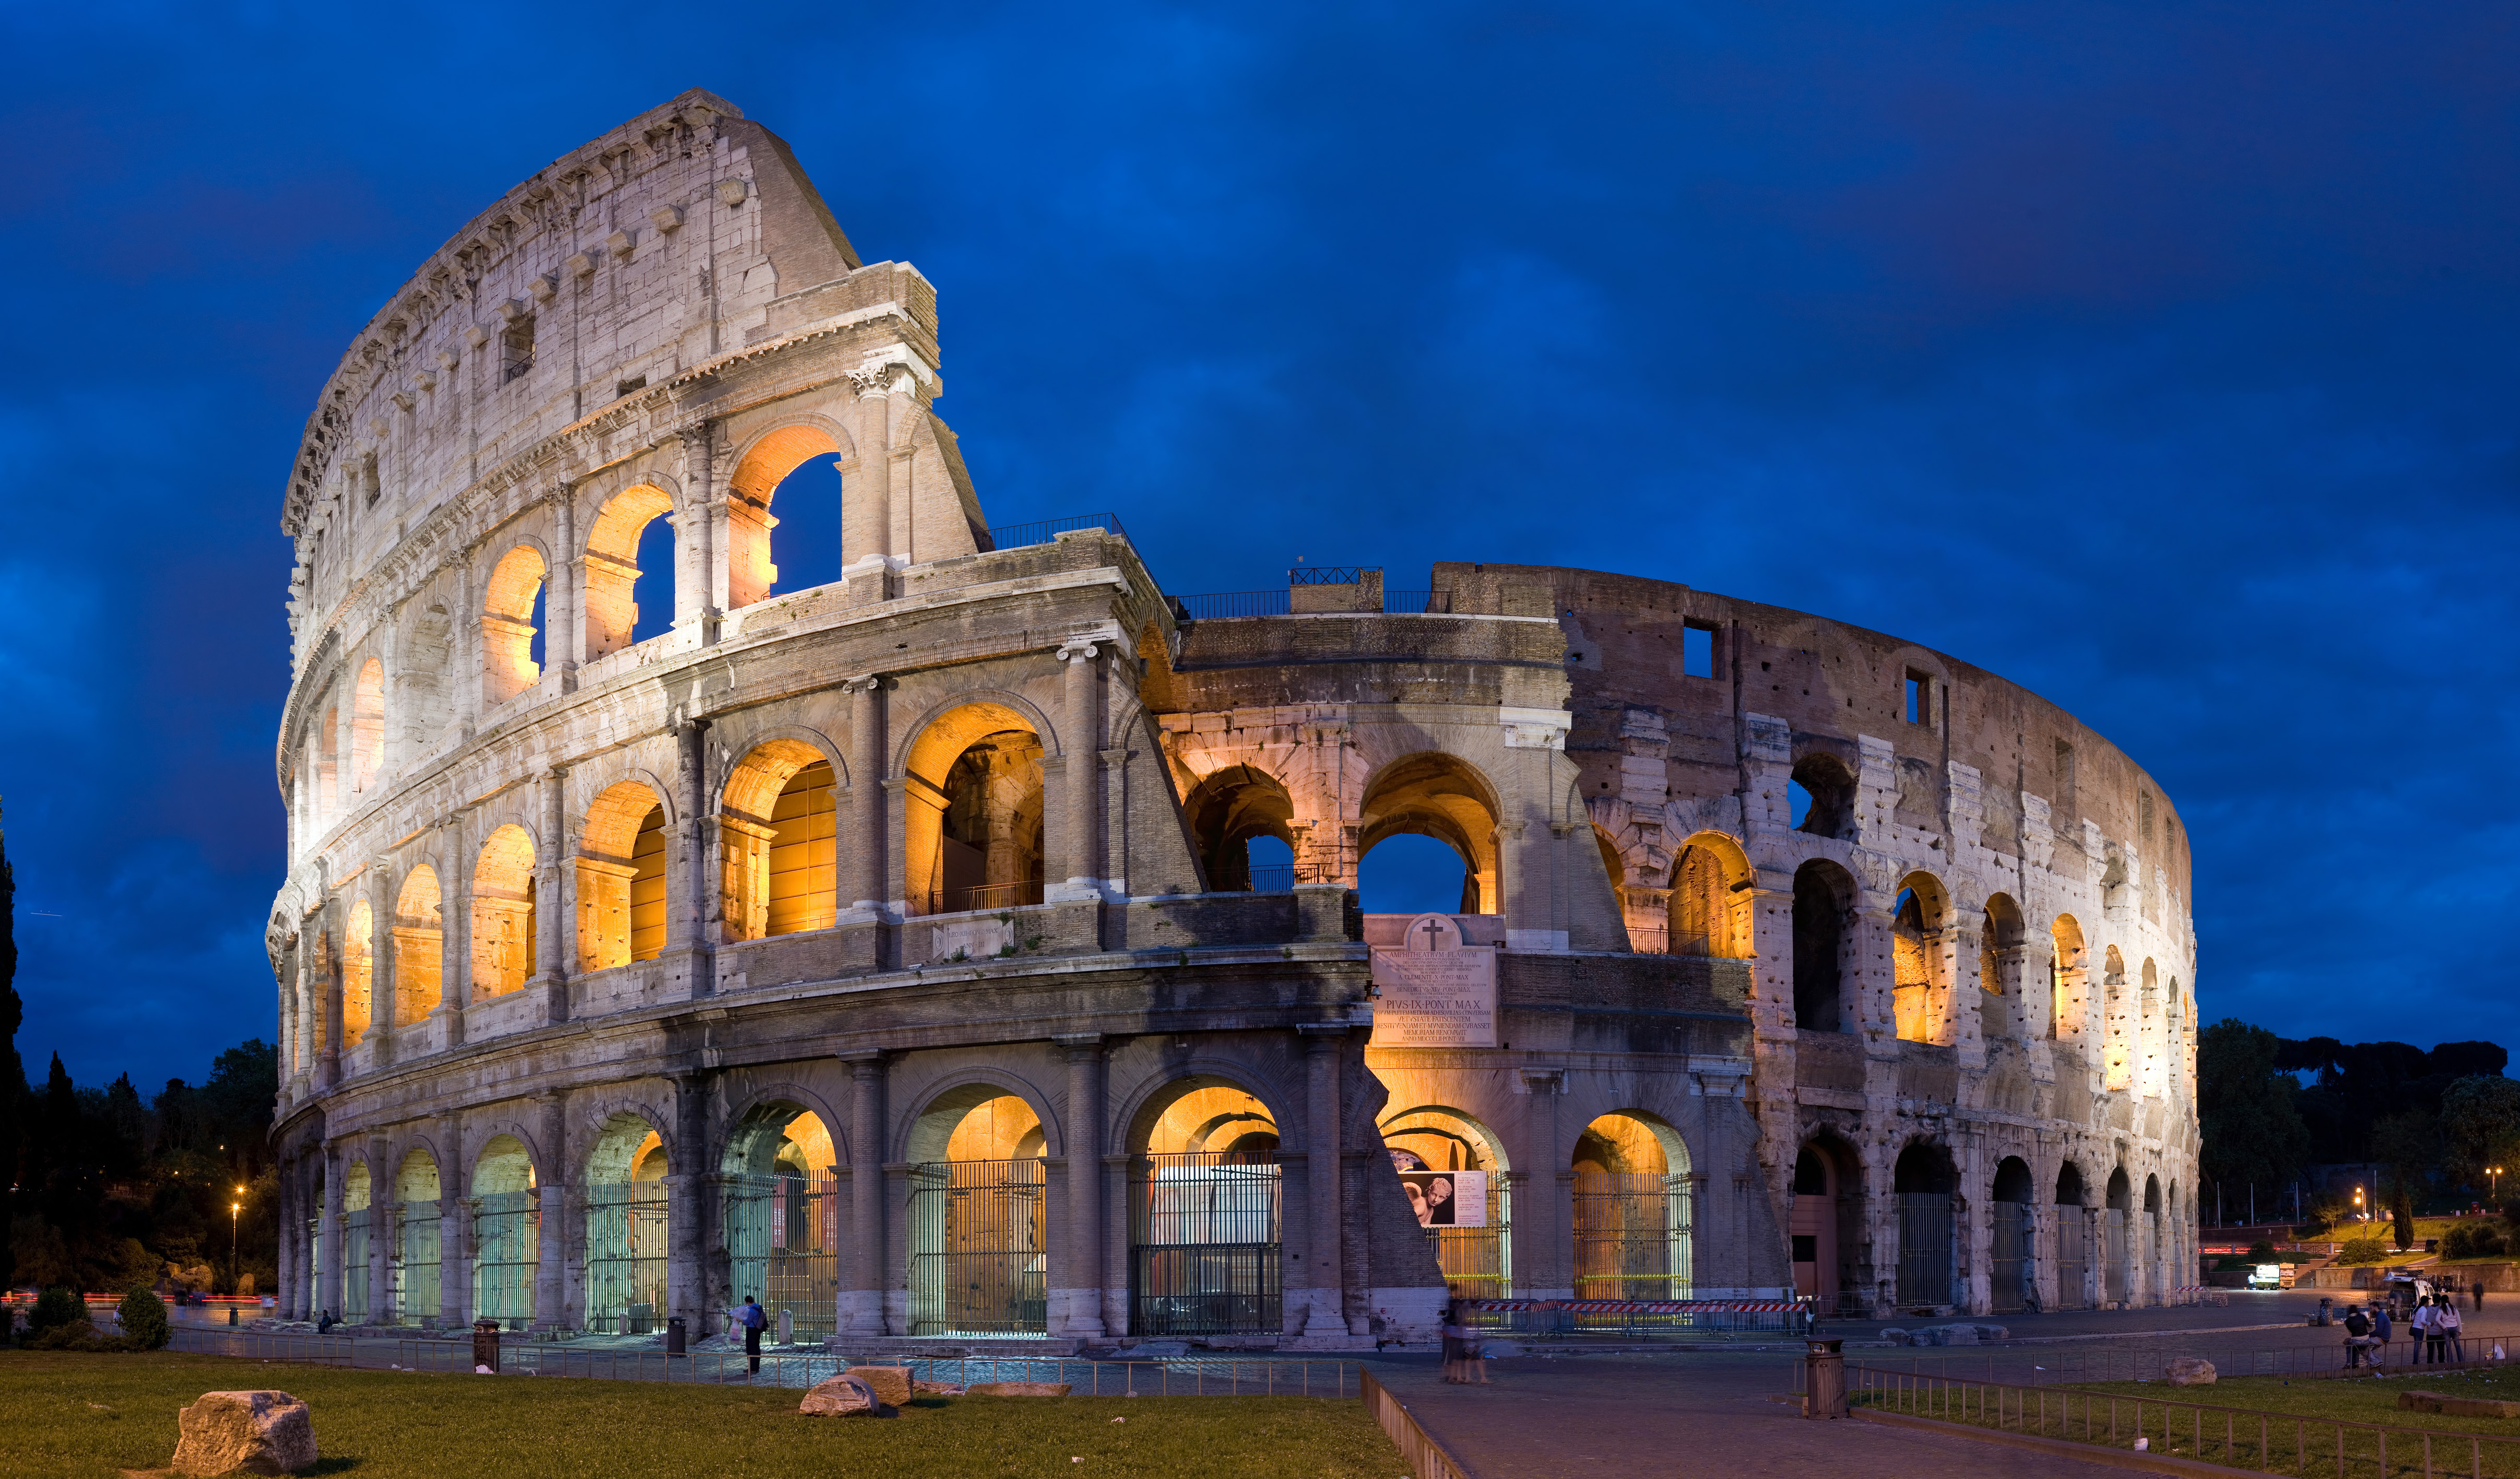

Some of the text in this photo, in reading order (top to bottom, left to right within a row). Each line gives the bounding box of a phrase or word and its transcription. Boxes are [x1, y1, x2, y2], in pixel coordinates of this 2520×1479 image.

[1387, 1000, 1481, 1009] PIVS IX PONT MAX
